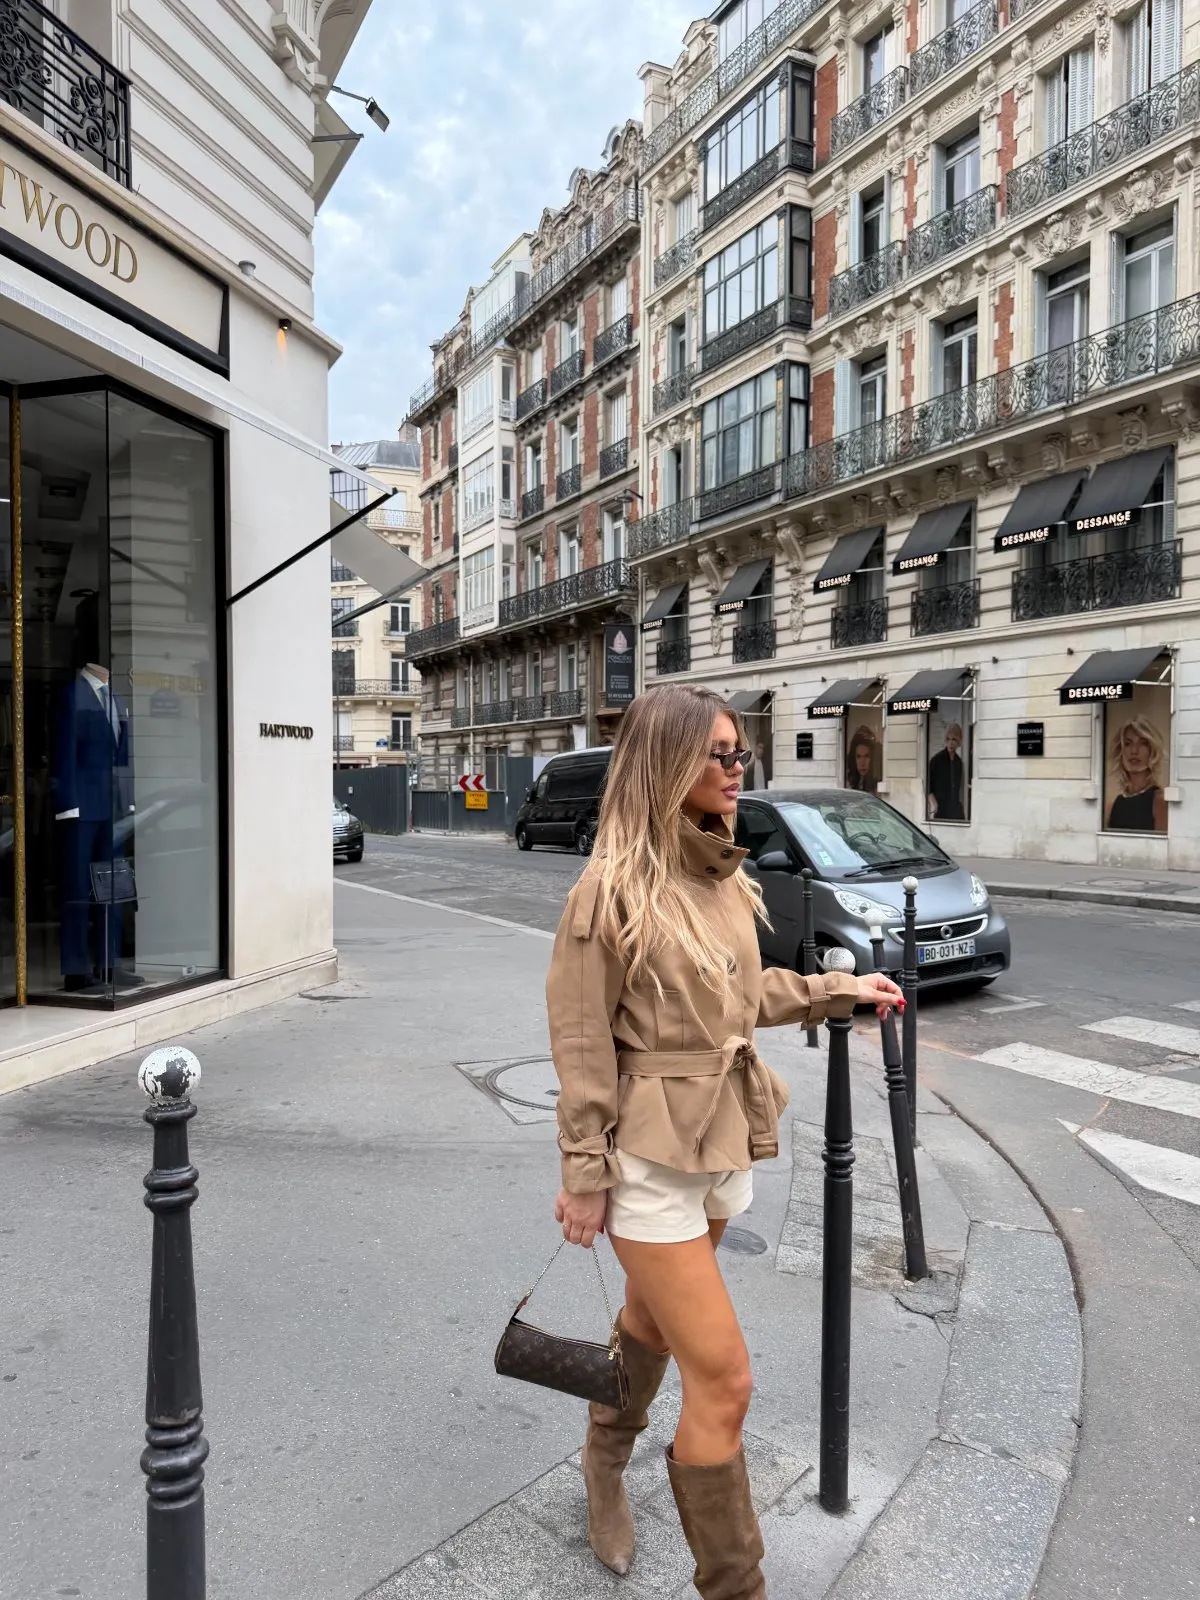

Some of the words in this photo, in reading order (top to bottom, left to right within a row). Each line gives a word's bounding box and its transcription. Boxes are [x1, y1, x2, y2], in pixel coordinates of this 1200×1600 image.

[1076, 511, 1131, 530] DESSANGE
[1001, 527, 1049, 547] DESSANGE
[900, 553, 938, 570] DESSANGE
[819, 574, 851, 588] DESSANGE
[1068, 684, 1122, 698] DESSANGE
[812, 705, 844, 715] DESSANGE
[893, 699, 931, 711] DESSANGE
[259, 722, 314, 740] HARTWOOD
[925, 942, 969, 960] BD-031-NZ
